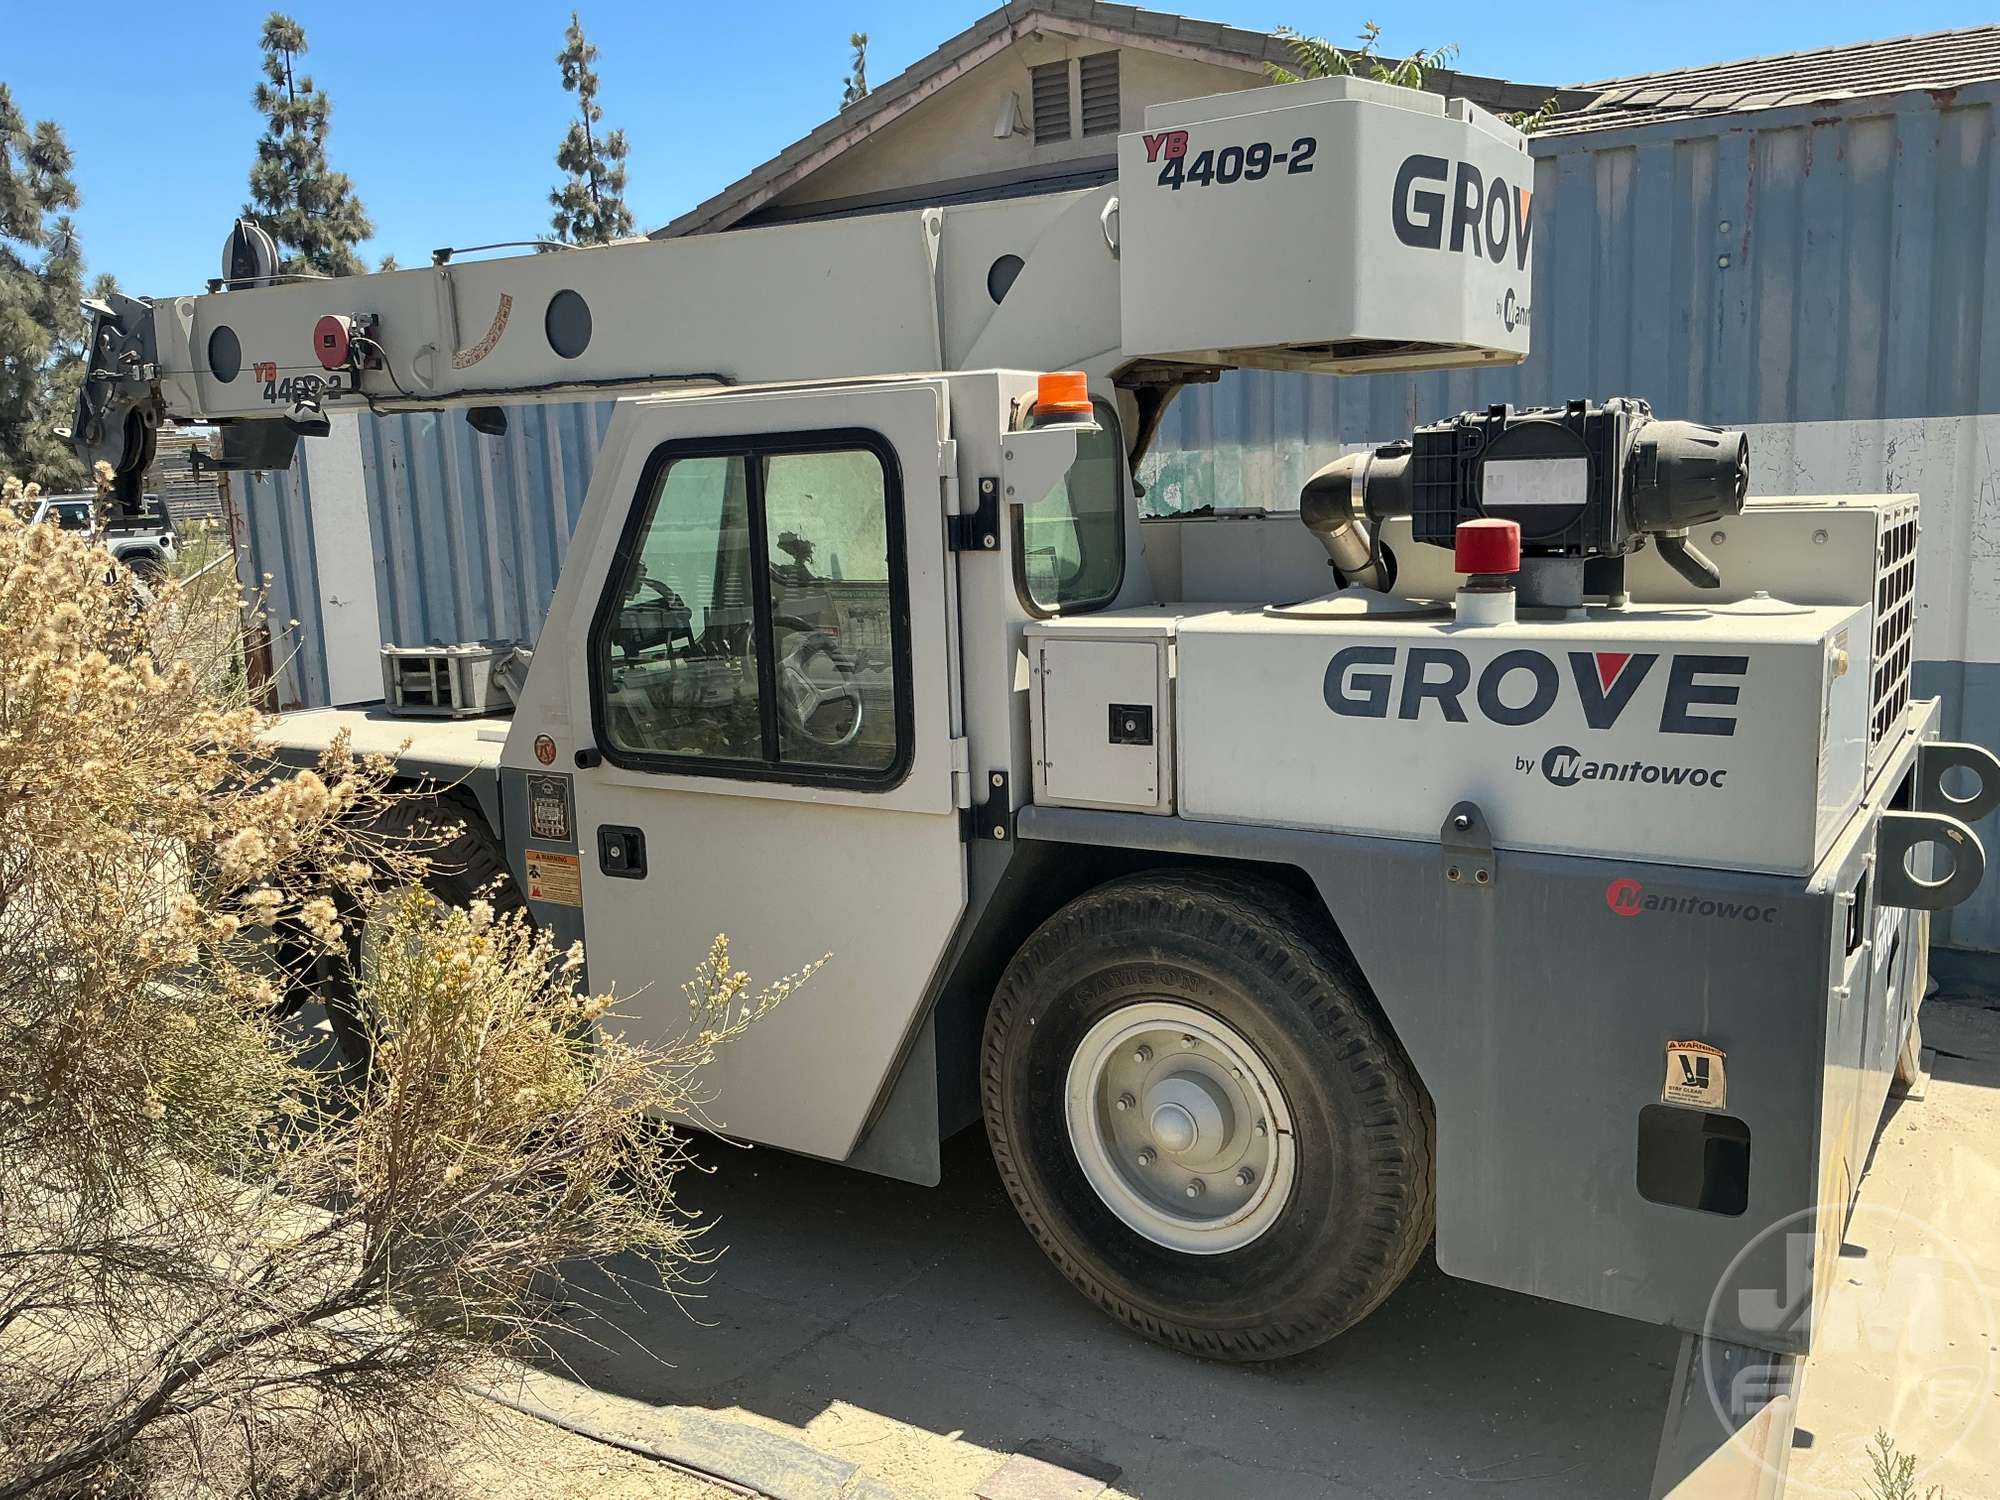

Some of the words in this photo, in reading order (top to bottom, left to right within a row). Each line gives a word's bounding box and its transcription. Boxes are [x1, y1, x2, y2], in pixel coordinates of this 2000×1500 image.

[1142, 130, 1189, 163] YB
[1158, 137, 1317, 190] 4409-2
[252, 361, 277, 383] YB
[1323, 645, 1750, 737] GROVE
[1514, 754, 1535, 775] by
[1541, 745, 1727, 789] Manitowoc
[1605, 878, 1778, 924] Manitowoc
[1677, 1042, 1721, 1054] WARNING
